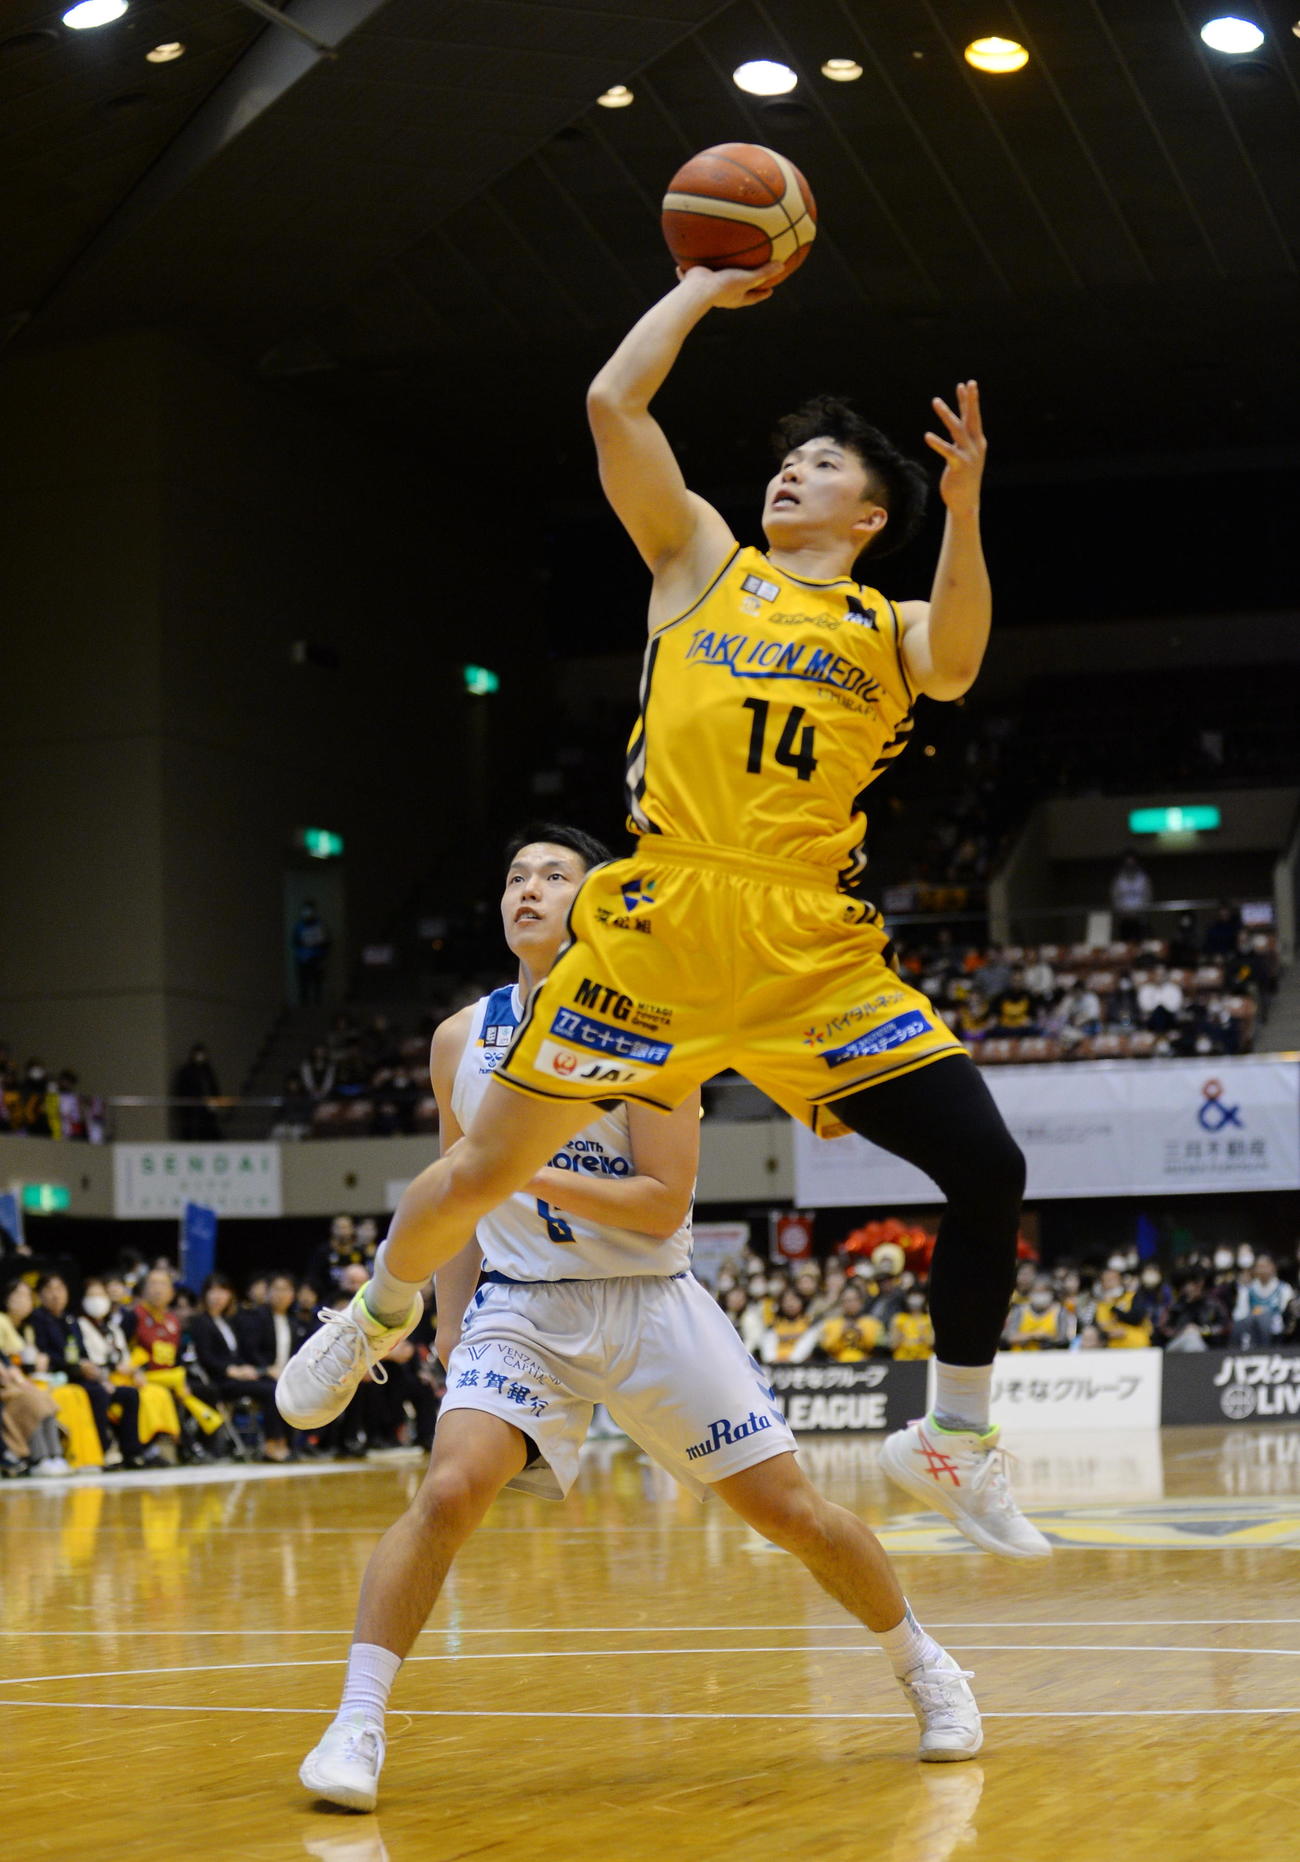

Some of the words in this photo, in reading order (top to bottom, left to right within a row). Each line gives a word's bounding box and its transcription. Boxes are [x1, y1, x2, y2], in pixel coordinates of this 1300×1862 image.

[742, 697, 818, 782] 14
[573, 978, 634, 1021] MTG
[141, 1154, 270, 1174] SENDAI
[456, 1368, 549, 1417] 滋賀銀行
